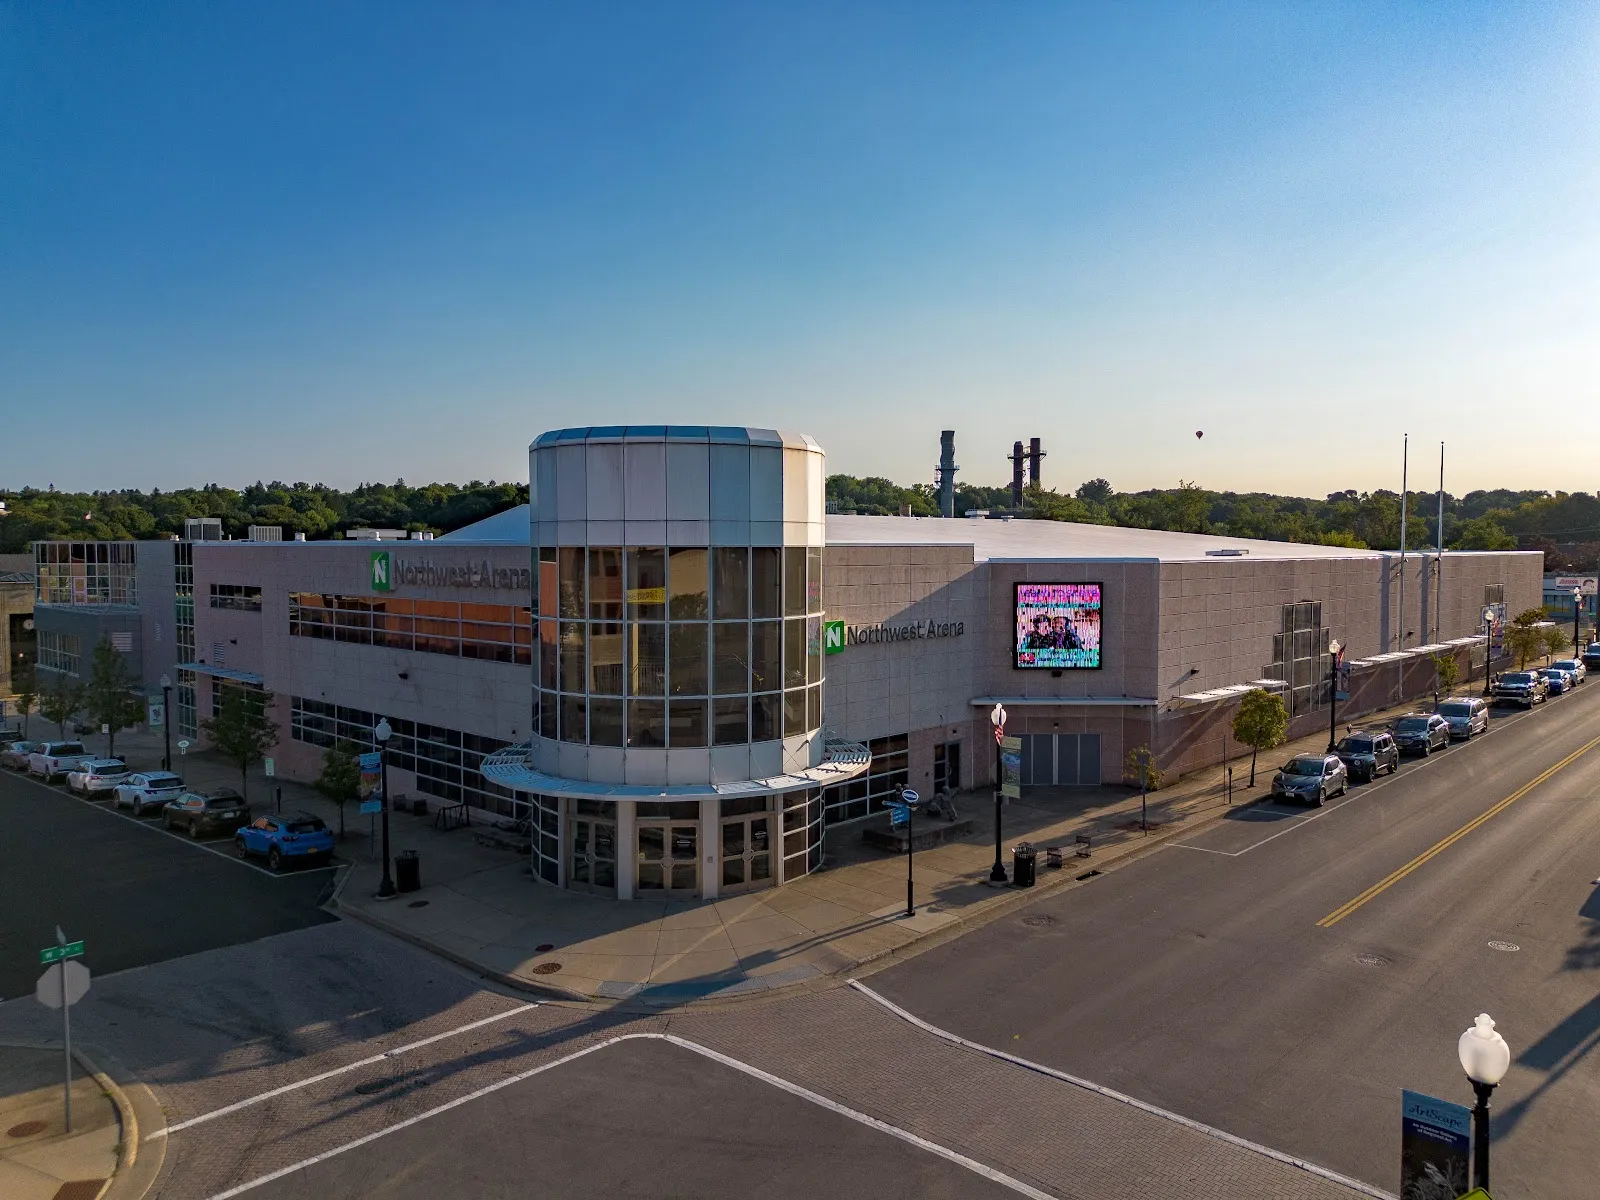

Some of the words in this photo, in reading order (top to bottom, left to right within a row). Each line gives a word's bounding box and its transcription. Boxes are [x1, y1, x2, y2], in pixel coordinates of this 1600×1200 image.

[394, 560, 474, 588] Northwest
[478, 561, 530, 589] Arena
[825, 624, 841, 648] N
[847, 621, 923, 645] Northwest
[926, 619, 964, 639] Arena
[45, 951, 53, 960] W
[1408, 1105, 1463, 1128] ArtScape
